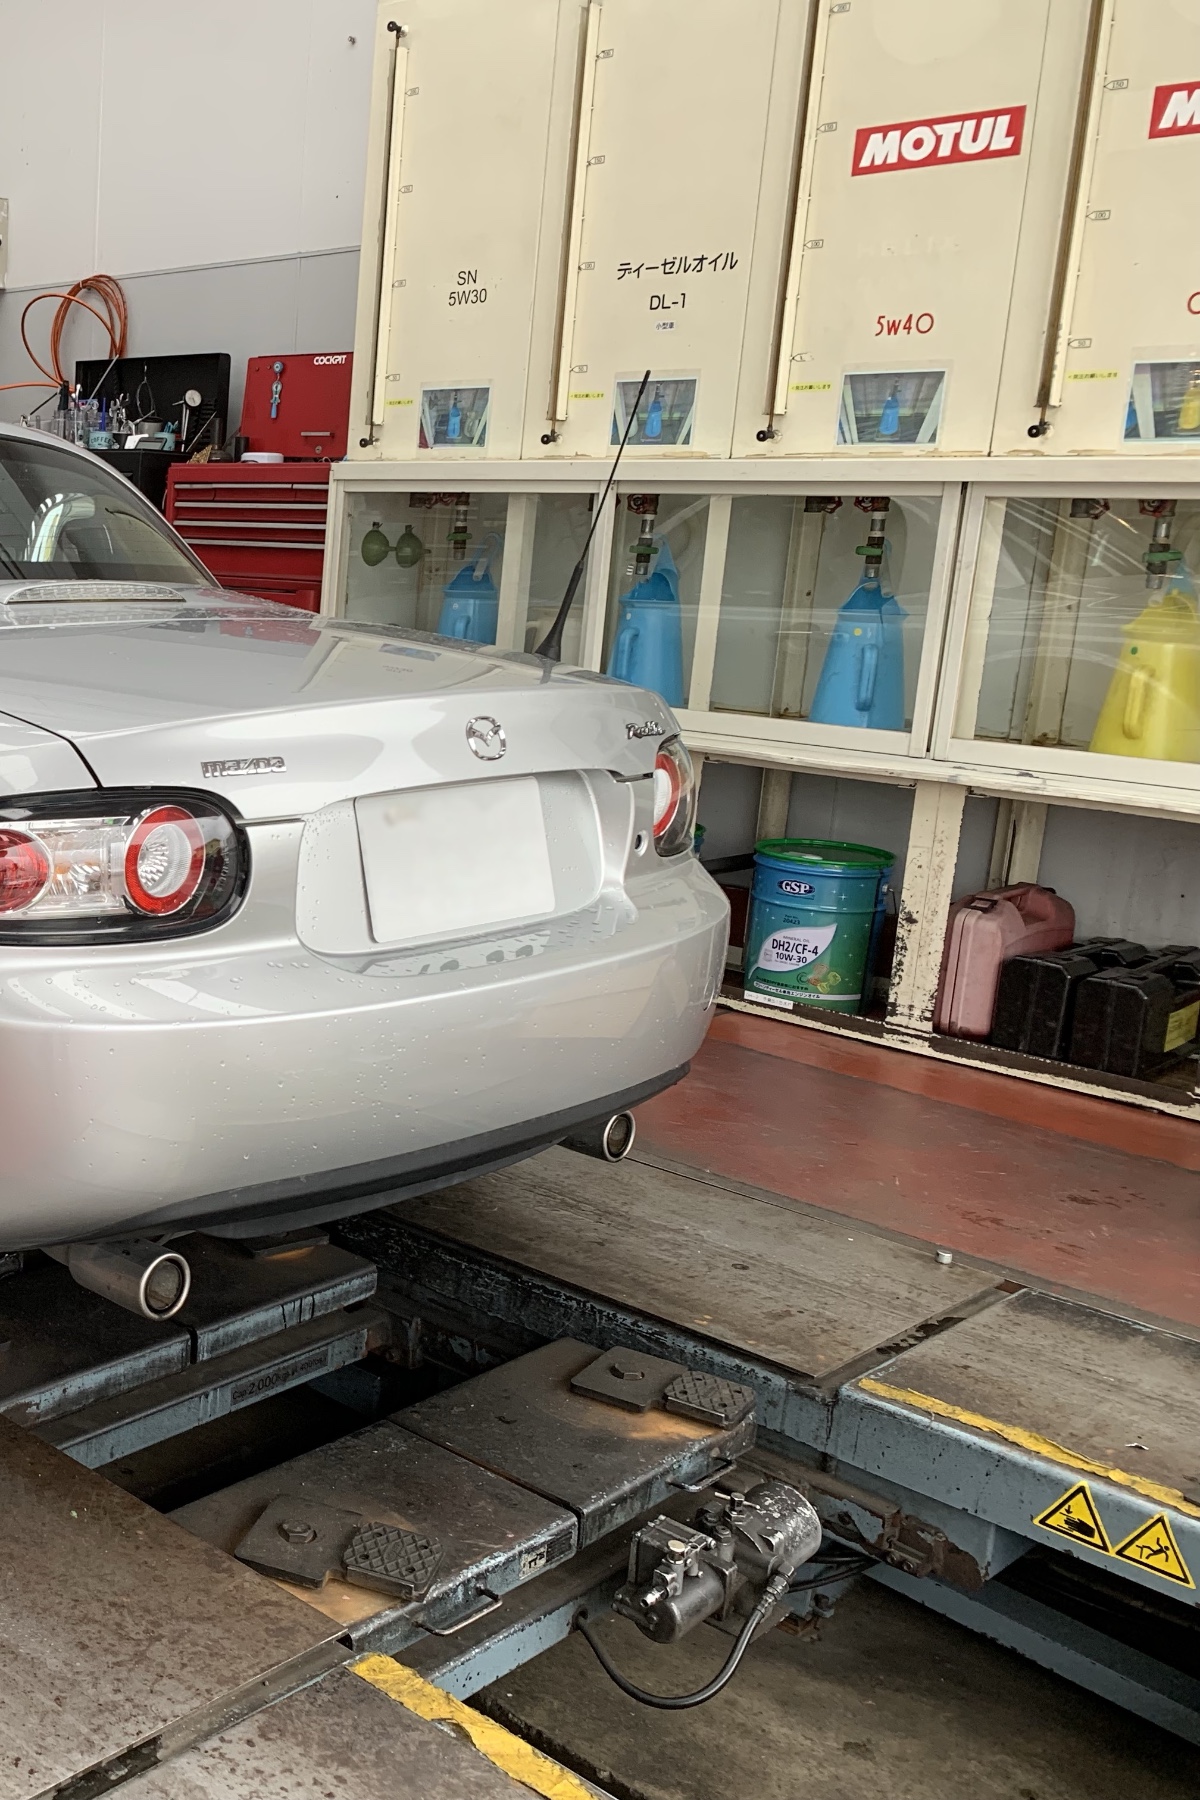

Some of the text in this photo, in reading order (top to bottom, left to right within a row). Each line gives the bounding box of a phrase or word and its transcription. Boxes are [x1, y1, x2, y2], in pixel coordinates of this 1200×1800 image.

[1158, 88, 1200, 129] M
[858, 114, 1015, 168] MOTUL
[617, 252, 738, 280] ディーゼルオイル
[457, 269, 478, 286] SN
[448, 288, 487, 306] 5W30
[649, 293, 686, 310] DL-1
[656, 322, 675, 330] 小型車
[313, 355, 347, 365] COCKPIT
[782, 880, 810, 894] GSP
[772, 938, 819, 956] DH2/CF-4
[775, 952, 807, 963] 10W-30
